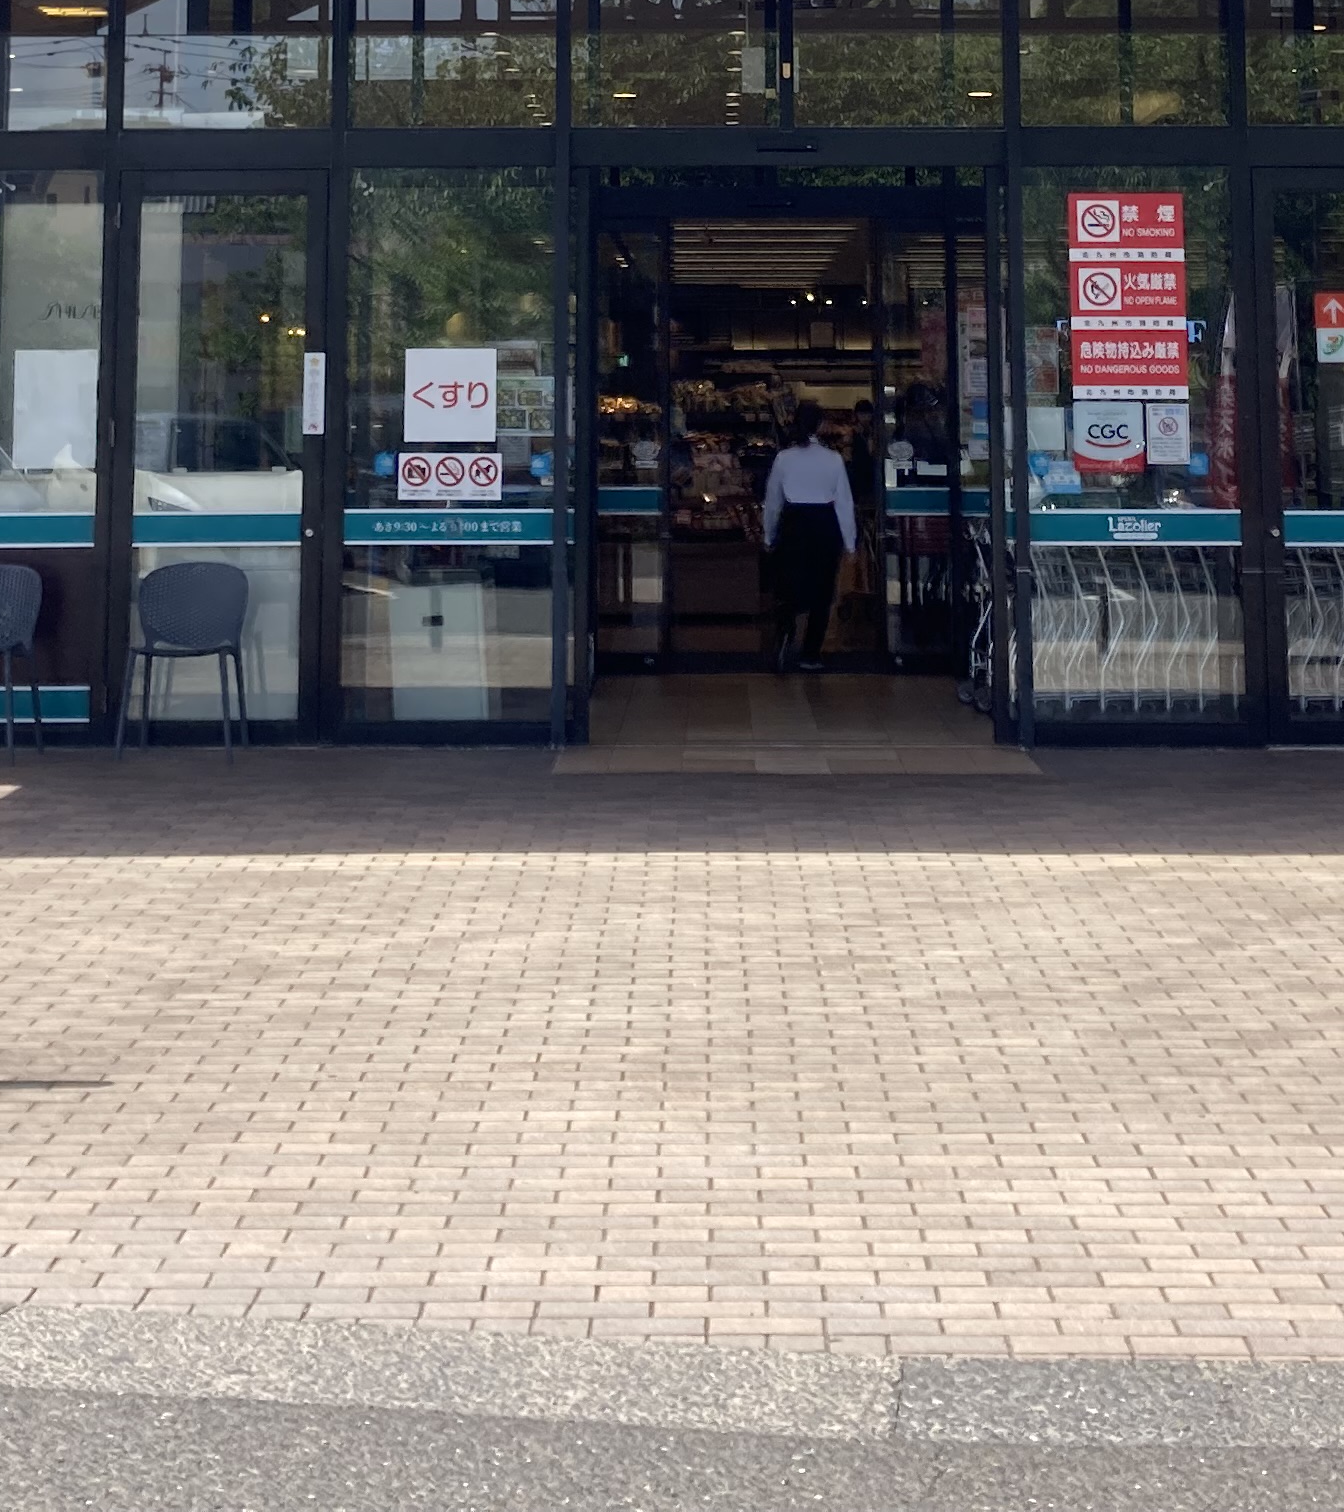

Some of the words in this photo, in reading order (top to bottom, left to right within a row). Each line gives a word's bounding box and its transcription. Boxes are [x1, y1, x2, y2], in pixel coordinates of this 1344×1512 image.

[1122, 228, 1135, 237] NO
[1137, 228, 1176, 237] SMOKING
[1123, 272, 1177, 291] 火気厳禁
[1124, 296, 1134, 306] NO
[1135, 296, 1155, 306] OPEN
[1155, 296, 1178, 306] FLAME
[1080, 341, 1180, 360] 危険物持込み厳禁
[1080, 365, 1093, 374] NO
[1095, 365, 1147, 374] DANGEROUS
[1149, 365, 1180, 374] GOODS
[412, 381, 490, 409] くすり
[1087, 423, 1129, 439] CGC
[1107, 516, 1162, 532] Lazolier
